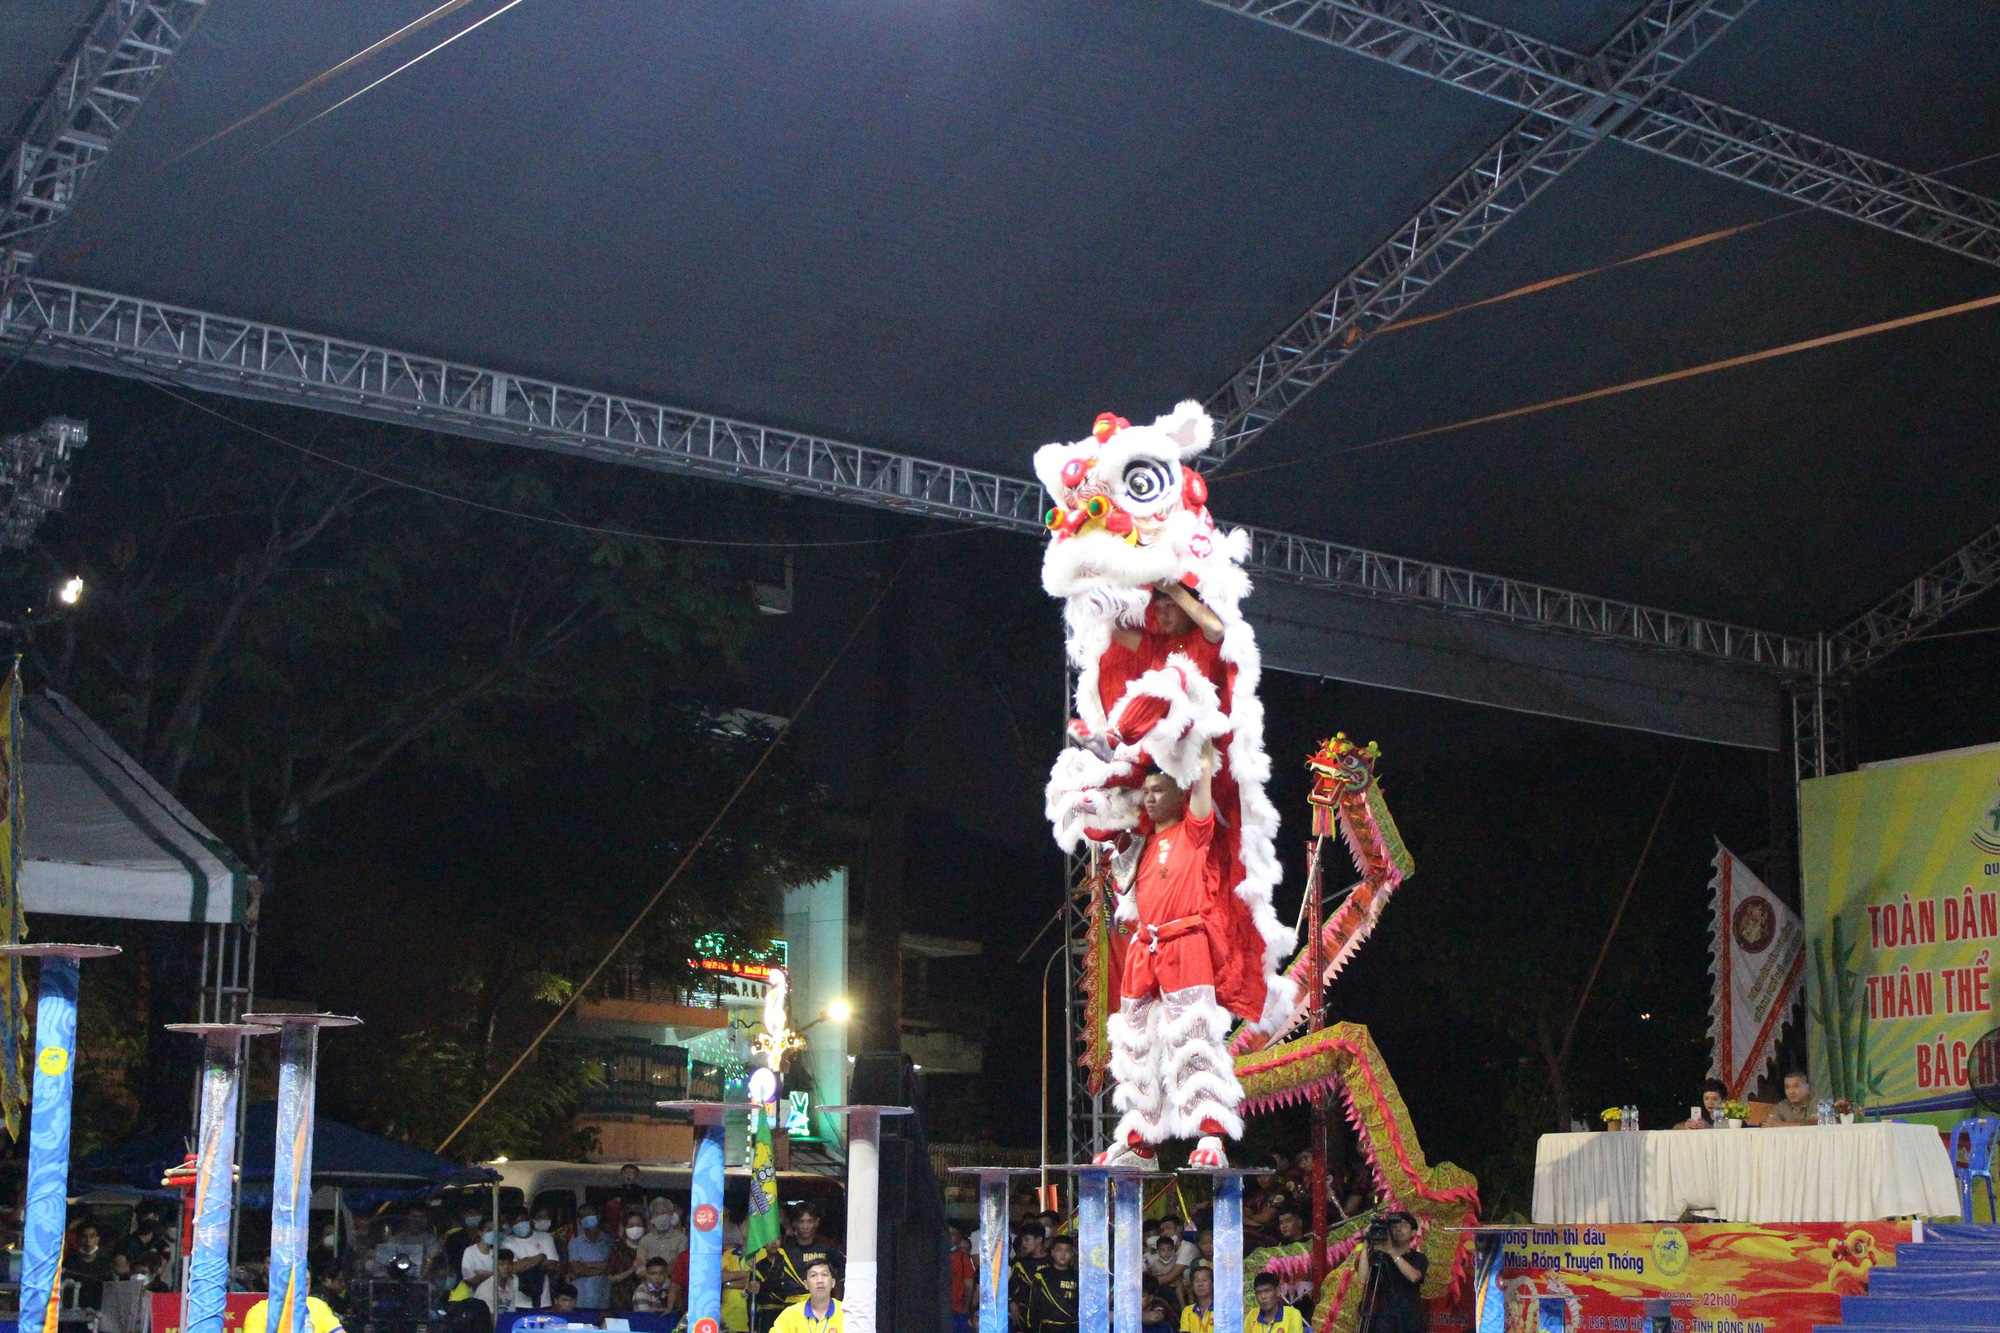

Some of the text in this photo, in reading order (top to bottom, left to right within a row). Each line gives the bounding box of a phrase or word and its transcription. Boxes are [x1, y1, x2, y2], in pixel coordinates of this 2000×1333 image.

[1868, 893, 1935, 949] TOÀN
[1944, 887, 1998, 942] DÂN
[1867, 950, 1991, 1020] THÂN THỂ
[1917, 1034, 1969, 1089] BÁC
[1532, 1228, 1559, 1245] trình
[1563, 1228, 1578, 1245] thi
[1583, 1226, 1606, 1246] đấu
[1504, 1249, 1644, 1275] Múa Rồng Truyền Thống
[1703, 1292, 1738, 1307] 22h00
[1609, 1316, 1628, 1330] TAM
